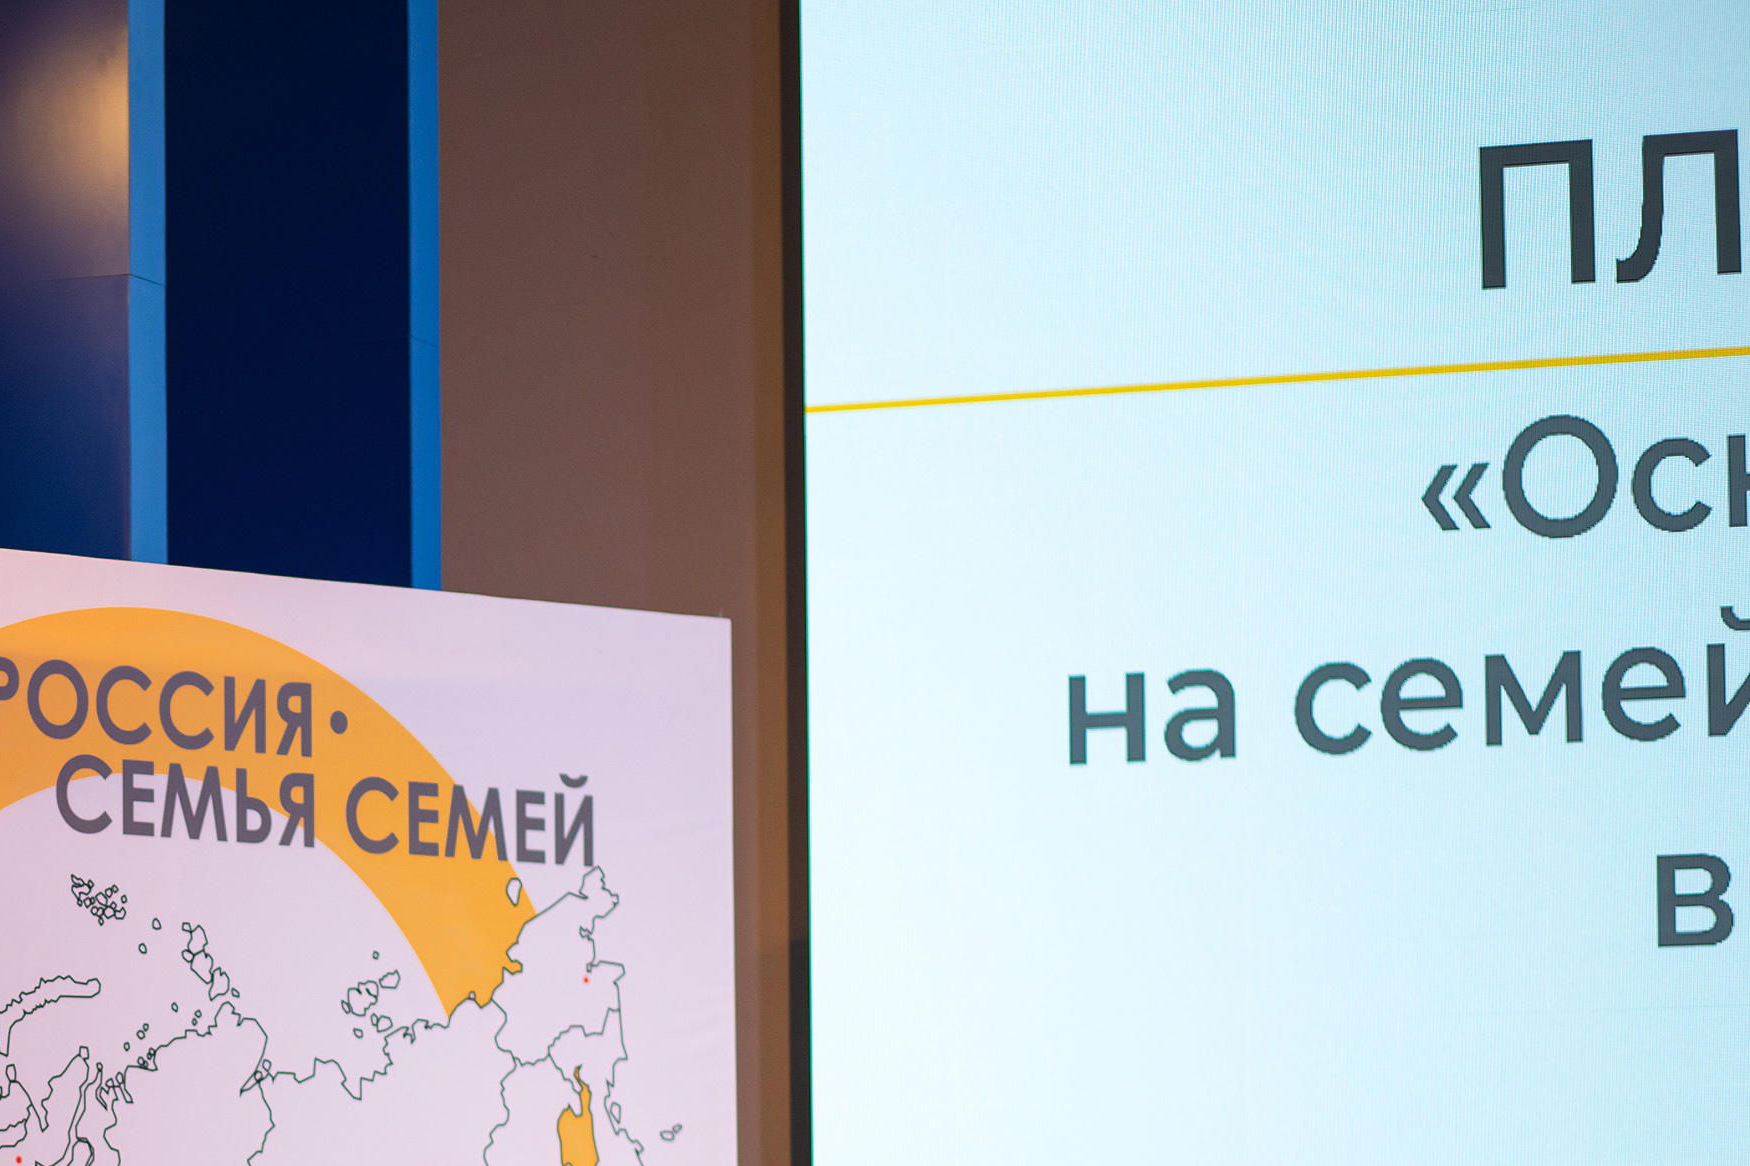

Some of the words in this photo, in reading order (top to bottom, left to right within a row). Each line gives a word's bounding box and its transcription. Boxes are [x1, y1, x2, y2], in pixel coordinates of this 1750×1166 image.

[1479, 129, 1742, 290] ПЛ
[1069, 669, 1236, 765] на
[56, 754, 315, 847] СЕМЬЯ
[346, 773, 594, 867] СЕМЕЙ
